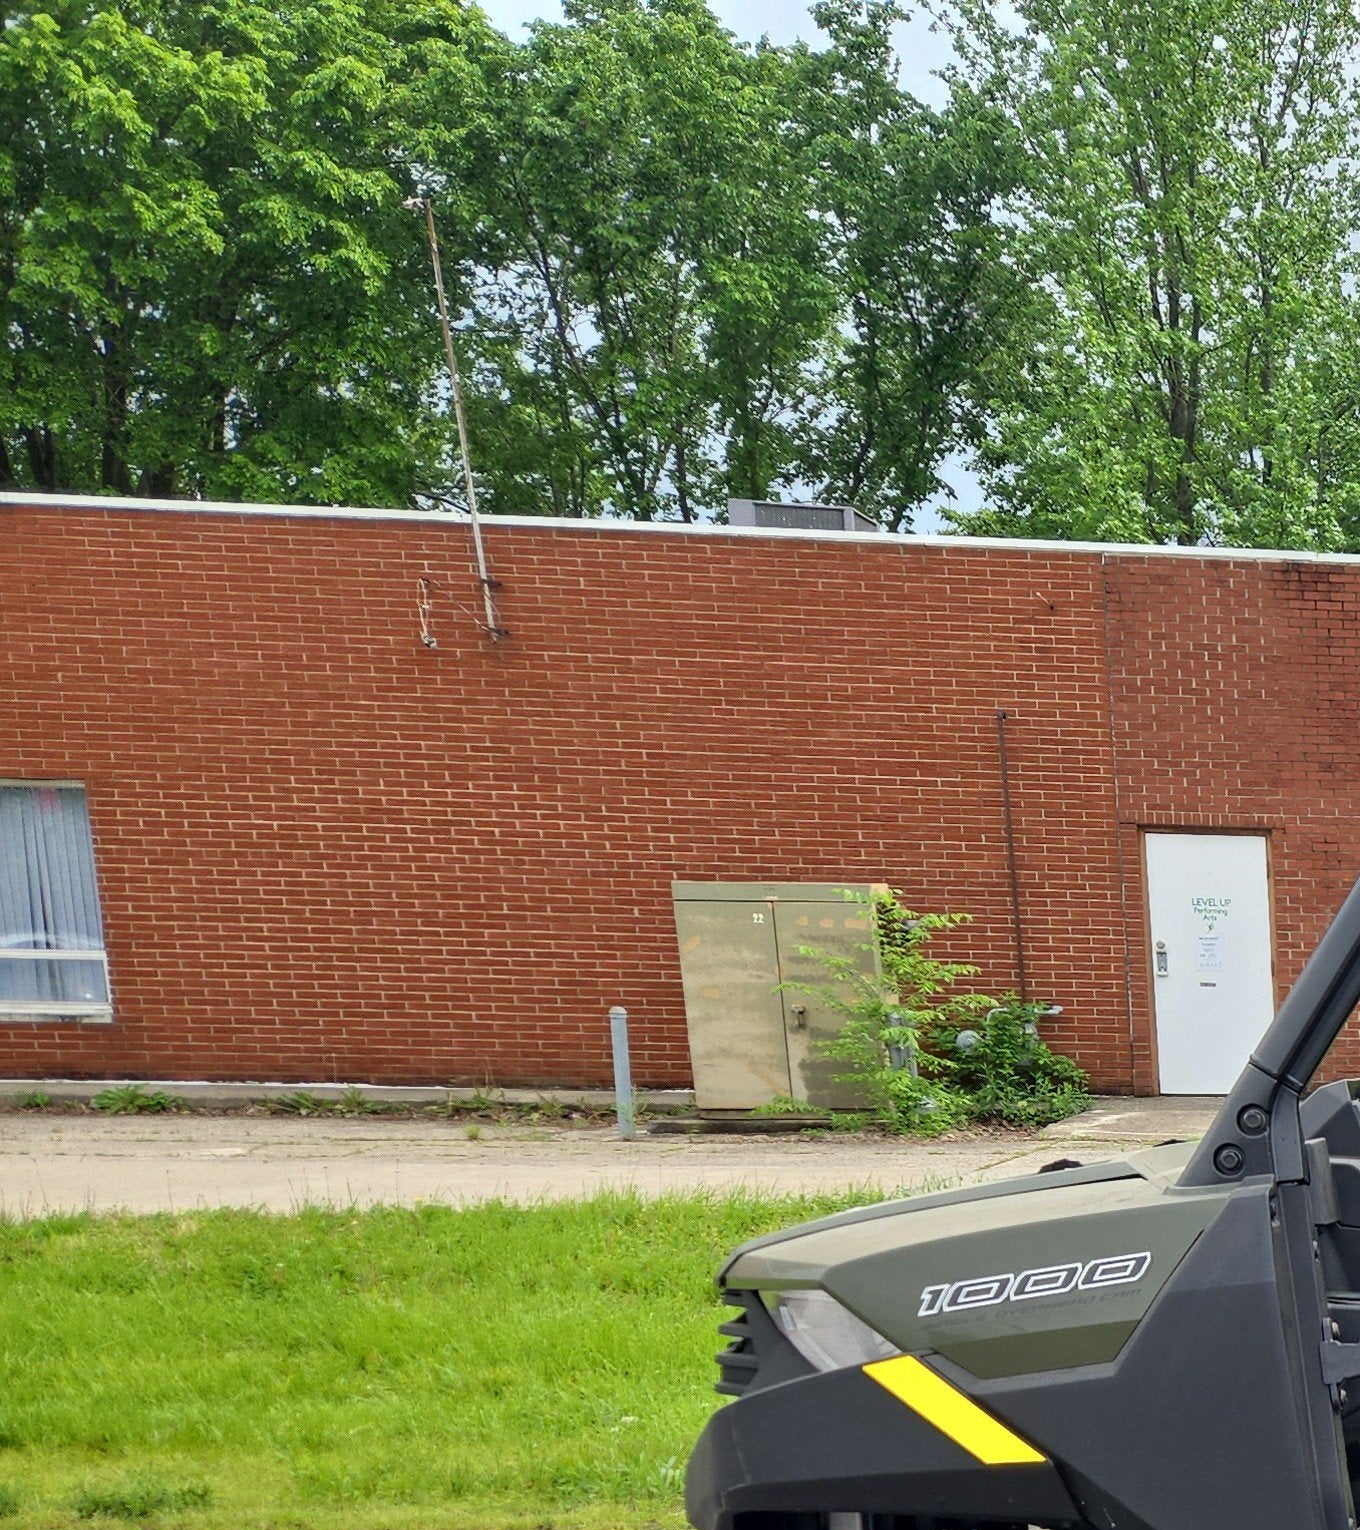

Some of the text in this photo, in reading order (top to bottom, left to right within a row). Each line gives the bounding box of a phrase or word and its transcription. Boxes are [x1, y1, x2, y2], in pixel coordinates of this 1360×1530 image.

[1191, 897, 1232, 907] LEVEL UP
[752, 912, 764, 923] 22
[917, 1250, 1151, 1317] 1000
